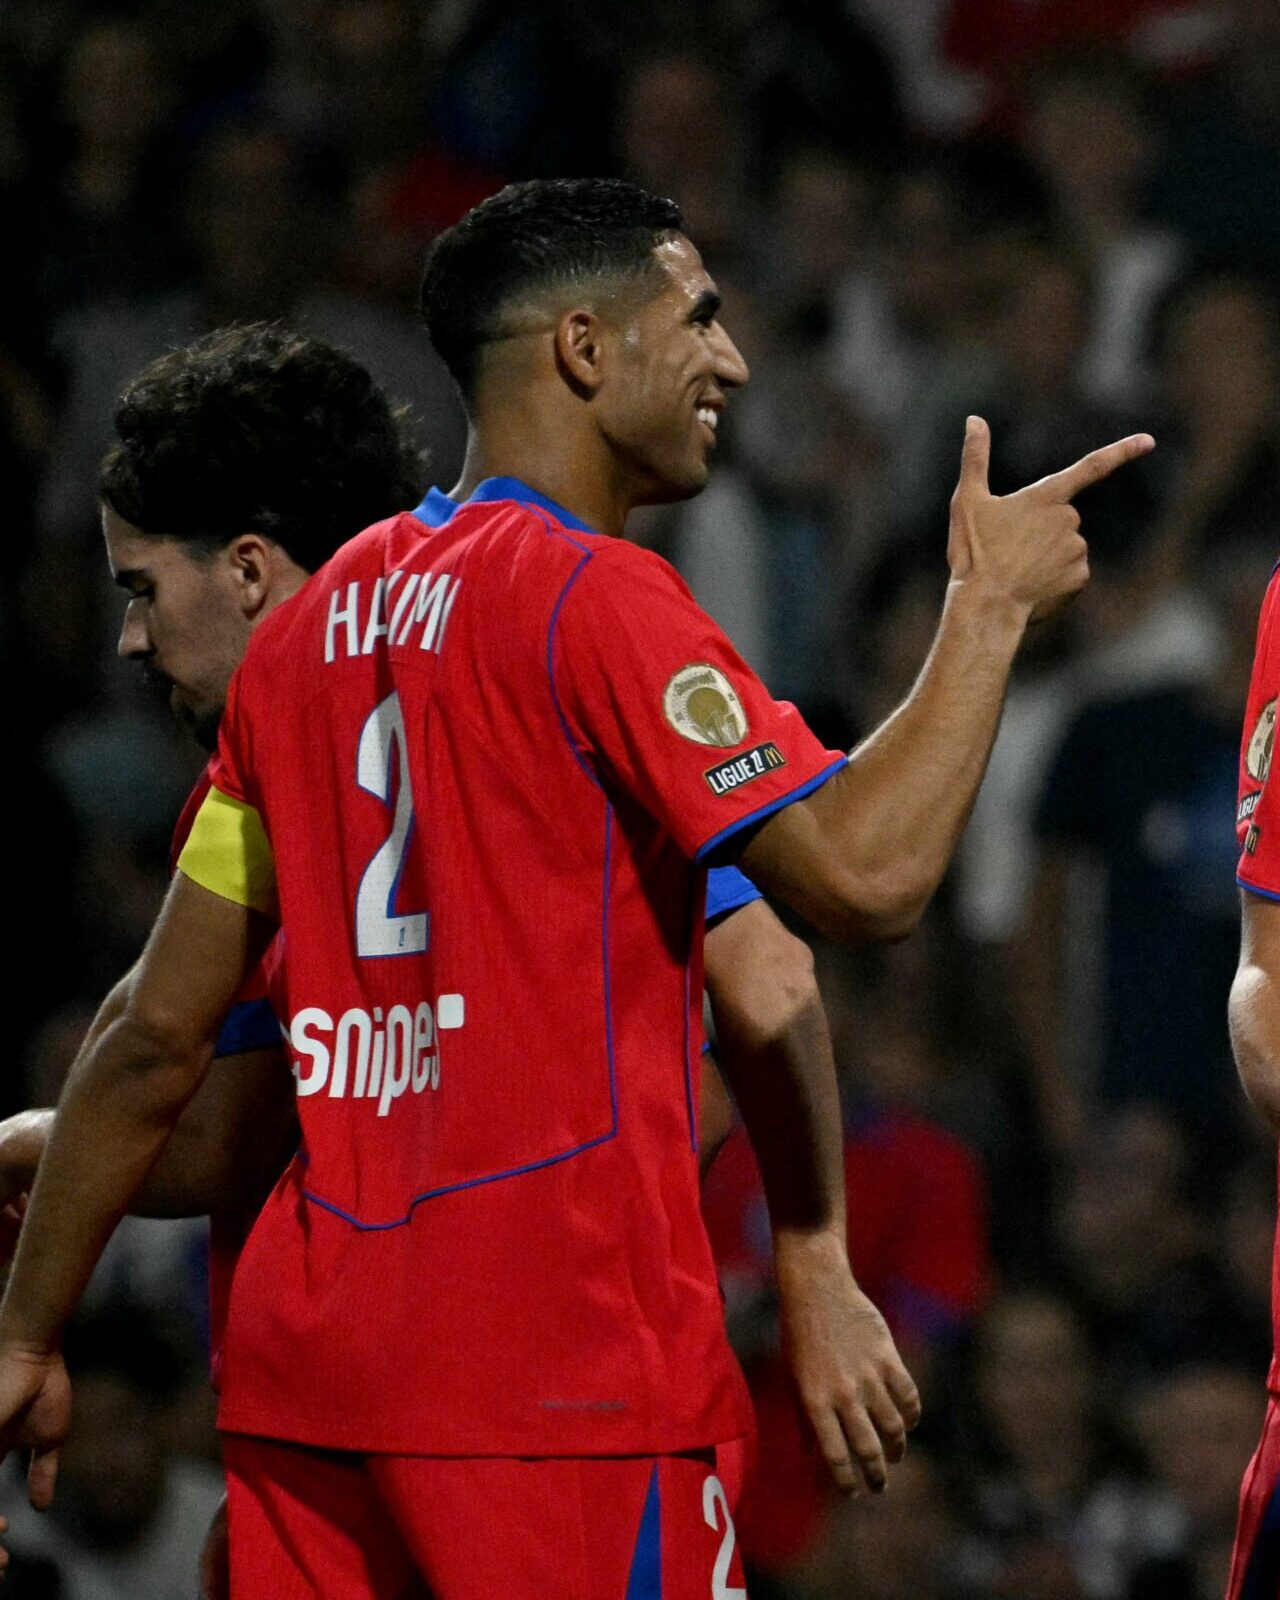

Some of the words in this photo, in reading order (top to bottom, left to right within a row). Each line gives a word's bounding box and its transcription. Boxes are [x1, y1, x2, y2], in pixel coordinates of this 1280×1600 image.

[356, 688, 431, 960] 2
[708, 757, 756, 794] LIGUE
[702, 1475, 748, 1600] 2
